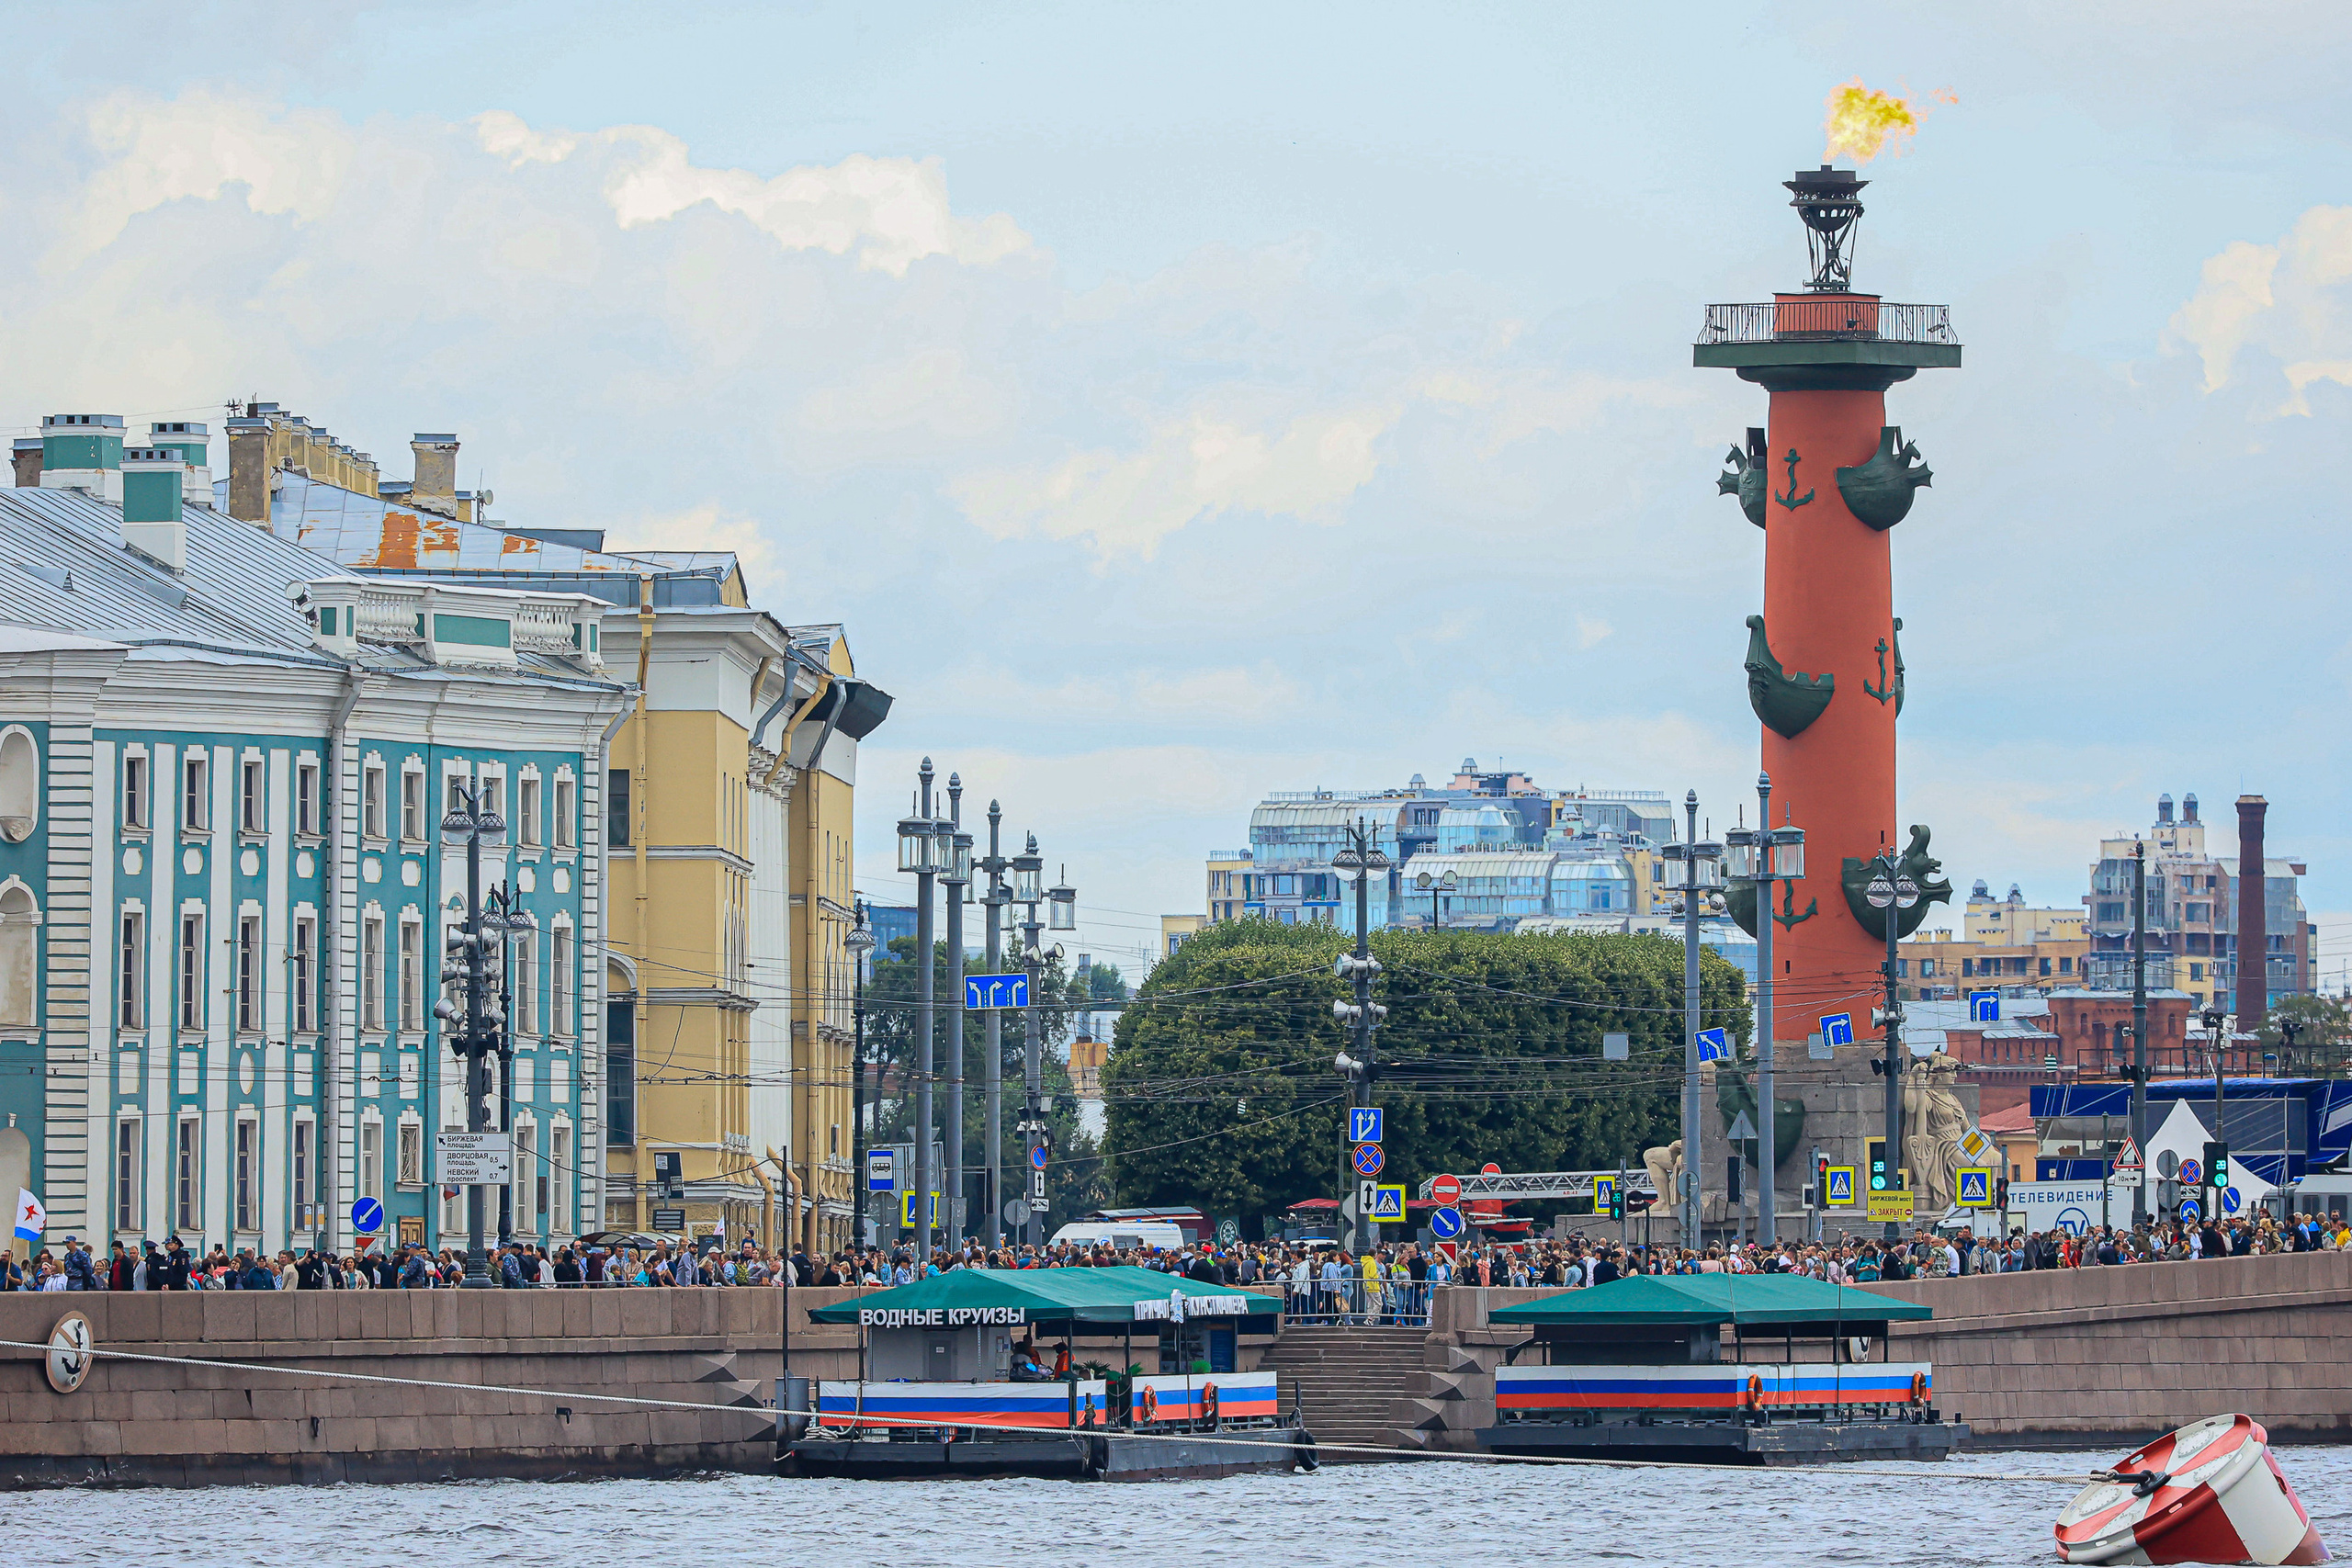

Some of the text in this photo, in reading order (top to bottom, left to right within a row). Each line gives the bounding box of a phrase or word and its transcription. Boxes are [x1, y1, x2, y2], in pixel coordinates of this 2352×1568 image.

[1873, 1161, 1884, 1172] 28
[2216, 1160, 2226, 1169] 28
[2009, 1190, 2113, 1204] ТЕЛЕВИДЕНИЕ
[1186, 1294, 1250, 1316] КУНСТКАМЕРА
[860, 1306, 1025, 1328] ВОДНЫЕ КРУИЗЫ
